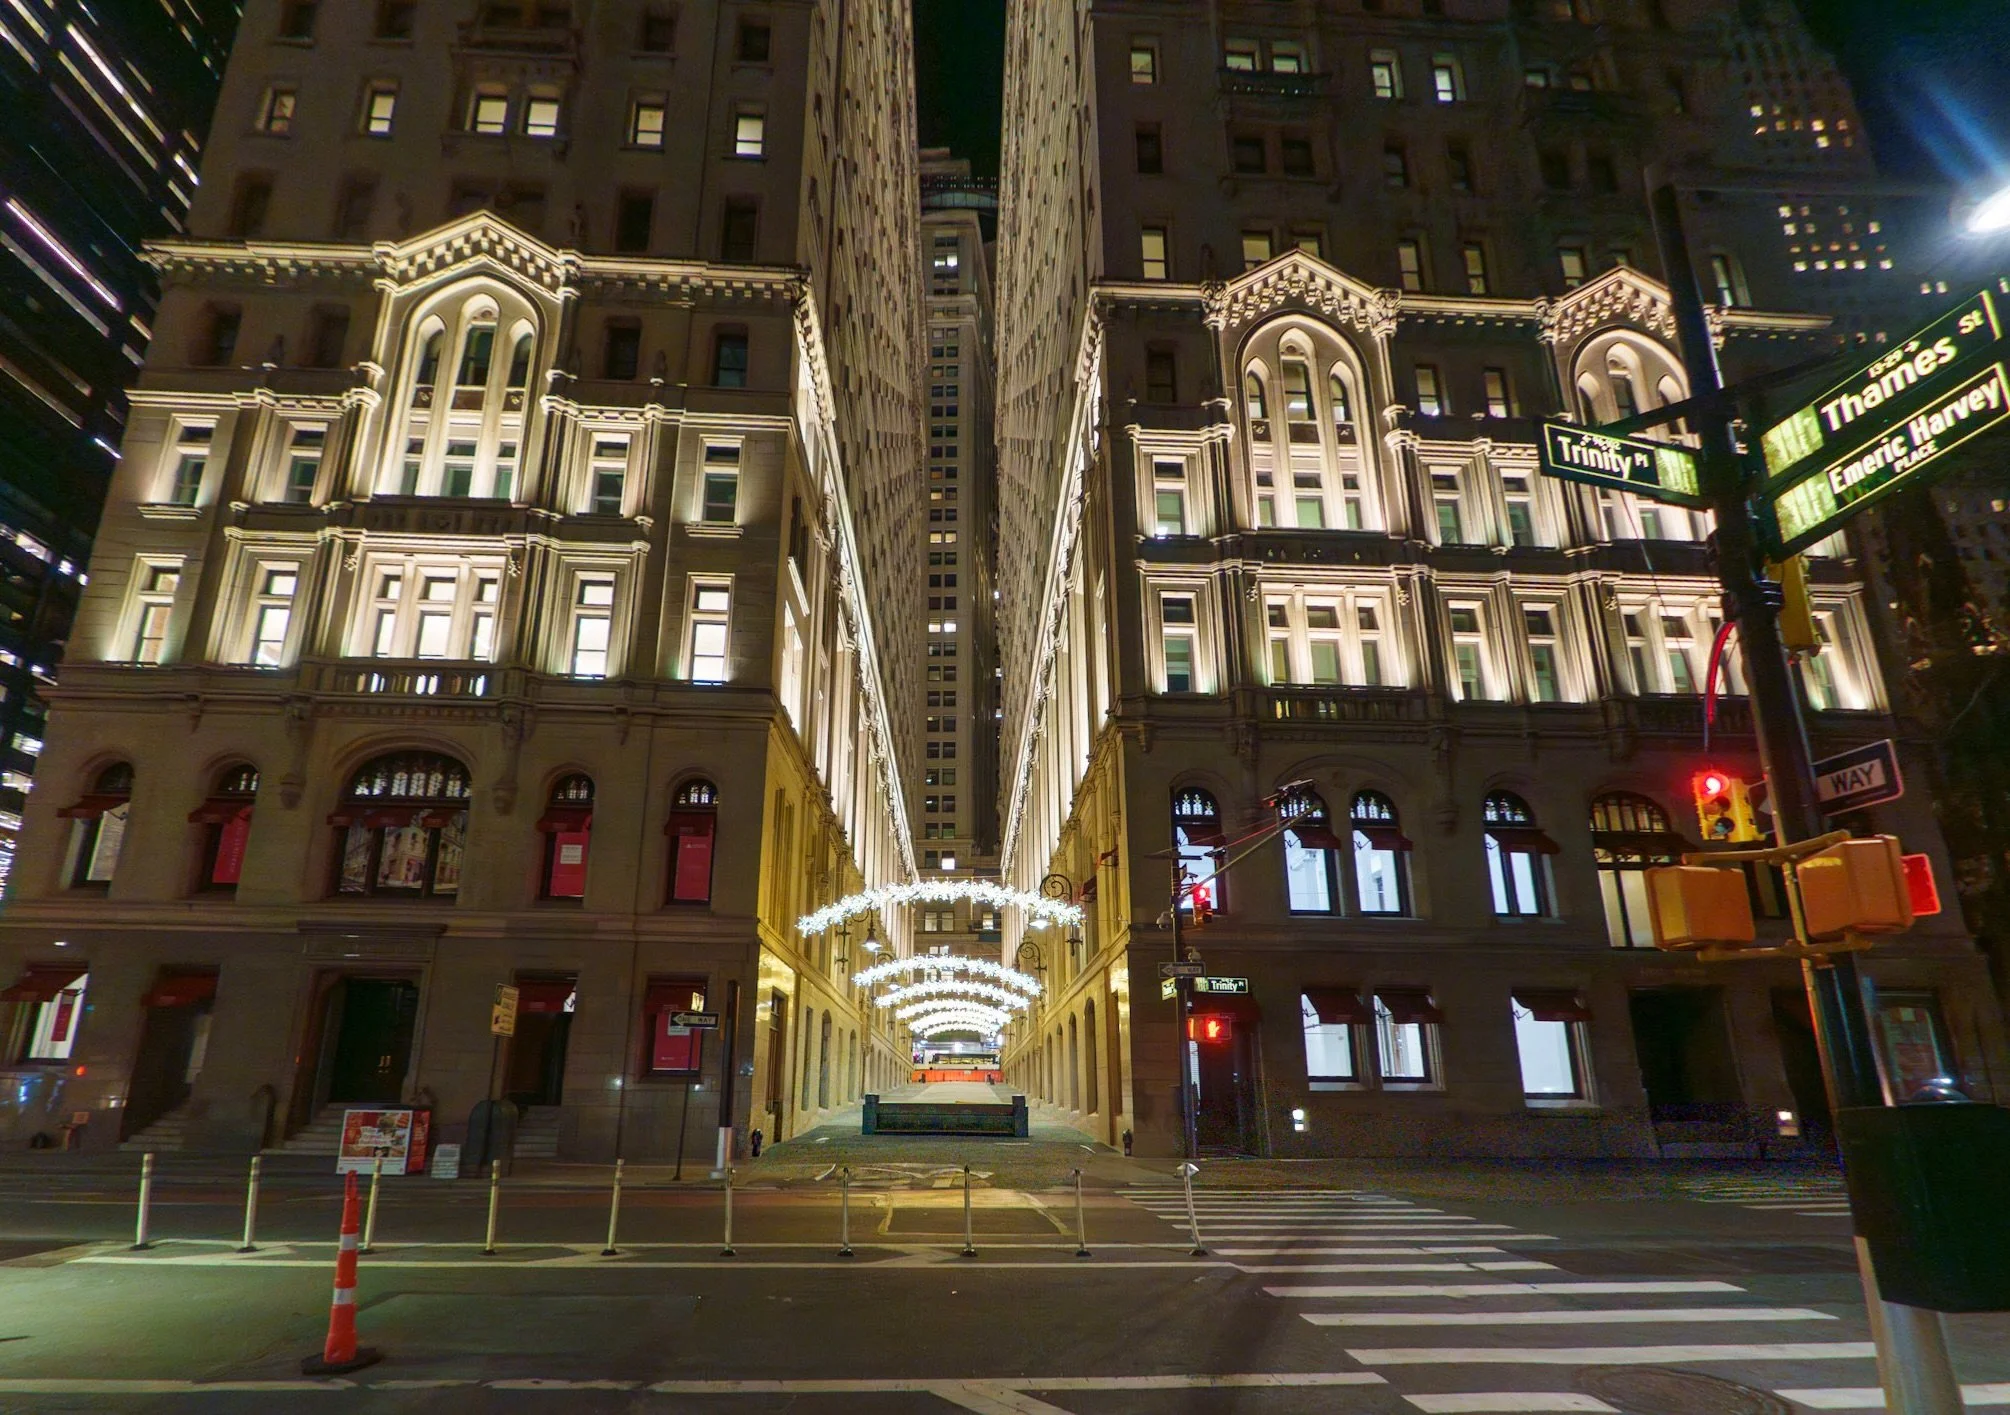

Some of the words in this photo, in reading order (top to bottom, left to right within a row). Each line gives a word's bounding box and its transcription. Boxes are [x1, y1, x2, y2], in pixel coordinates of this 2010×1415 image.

[1820, 336, 1958, 432] Thames
[1957, 309, 1985, 335] St
[1828, 435, 1908, 495] Emeric
[1908, 377, 2000, 446] Harvey
[1557, 435, 1632, 480] Trinity
[1893, 439, 1939, 474] PLACE
[1830, 763, 1874, 795] WAY
[1211, 980, 1238, 992] Trinity
